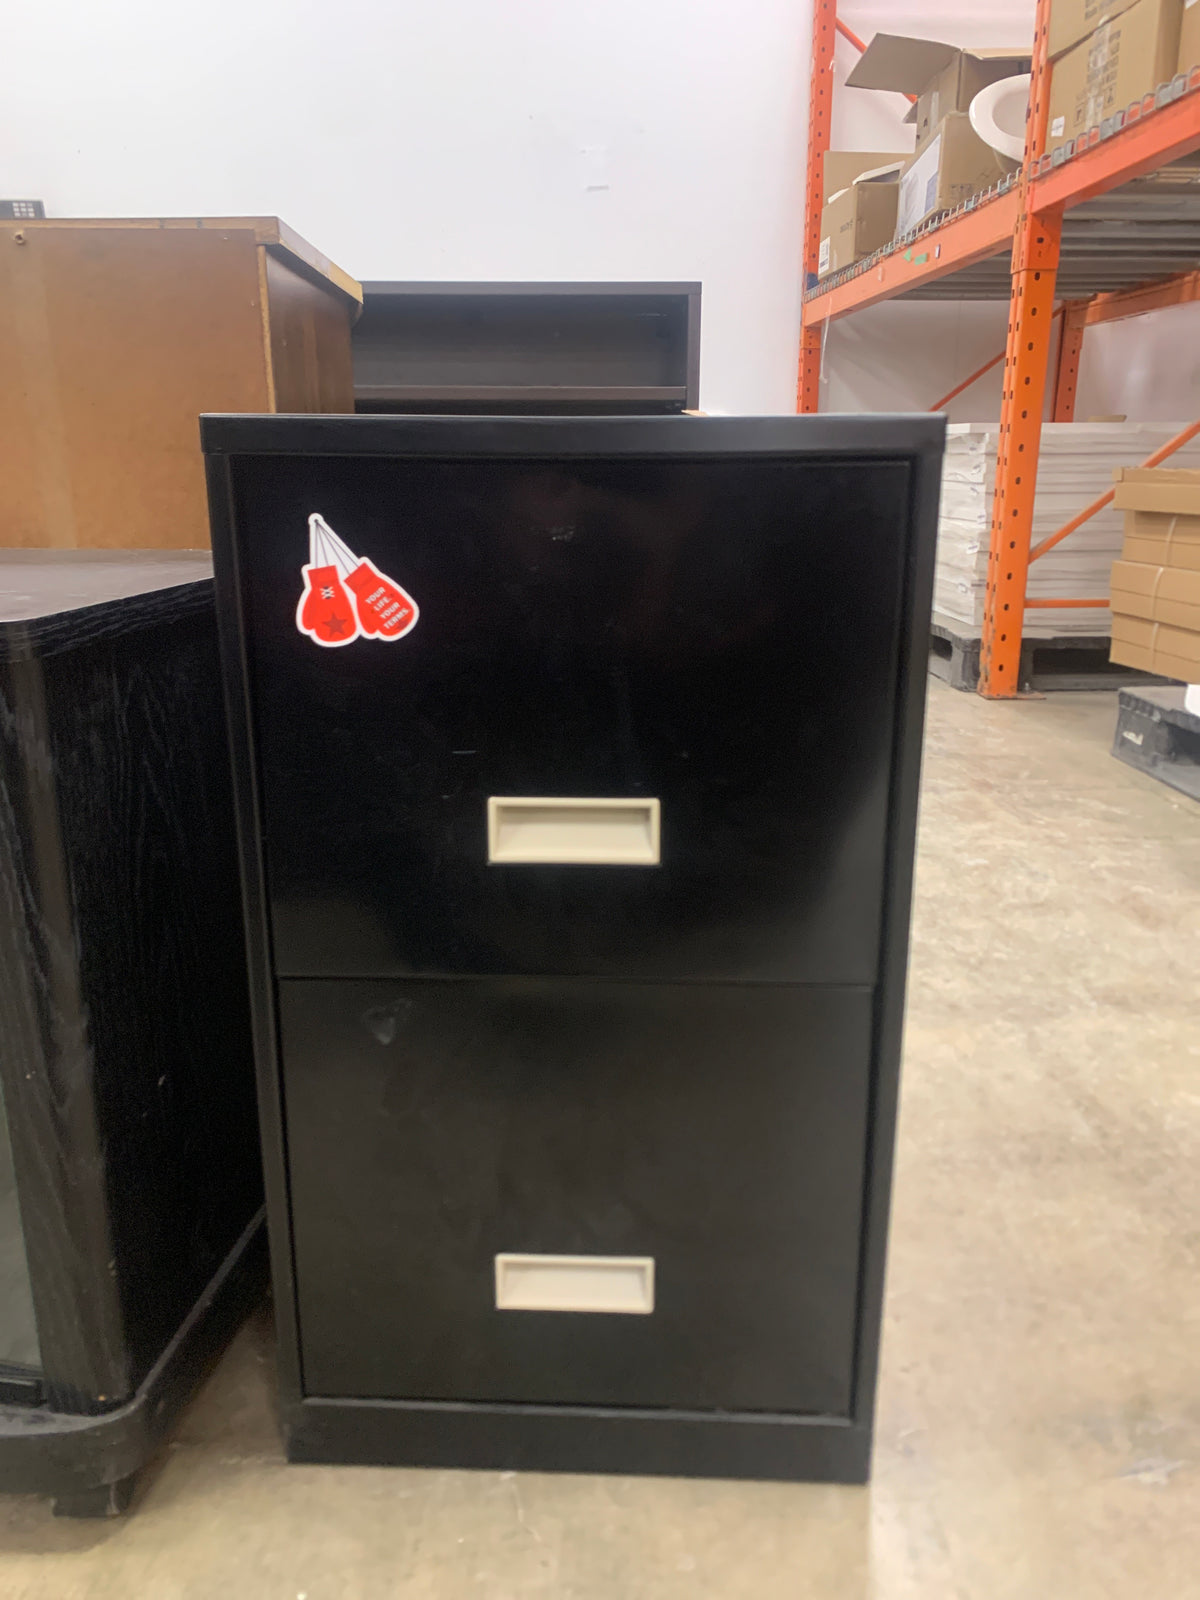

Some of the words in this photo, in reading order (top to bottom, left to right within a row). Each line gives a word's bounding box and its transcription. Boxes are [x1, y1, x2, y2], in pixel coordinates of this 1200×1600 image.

[365, 586, 386, 604] YOUR
[373, 595, 392, 611] LIFE.
[380, 601, 400, 619] YOUR
